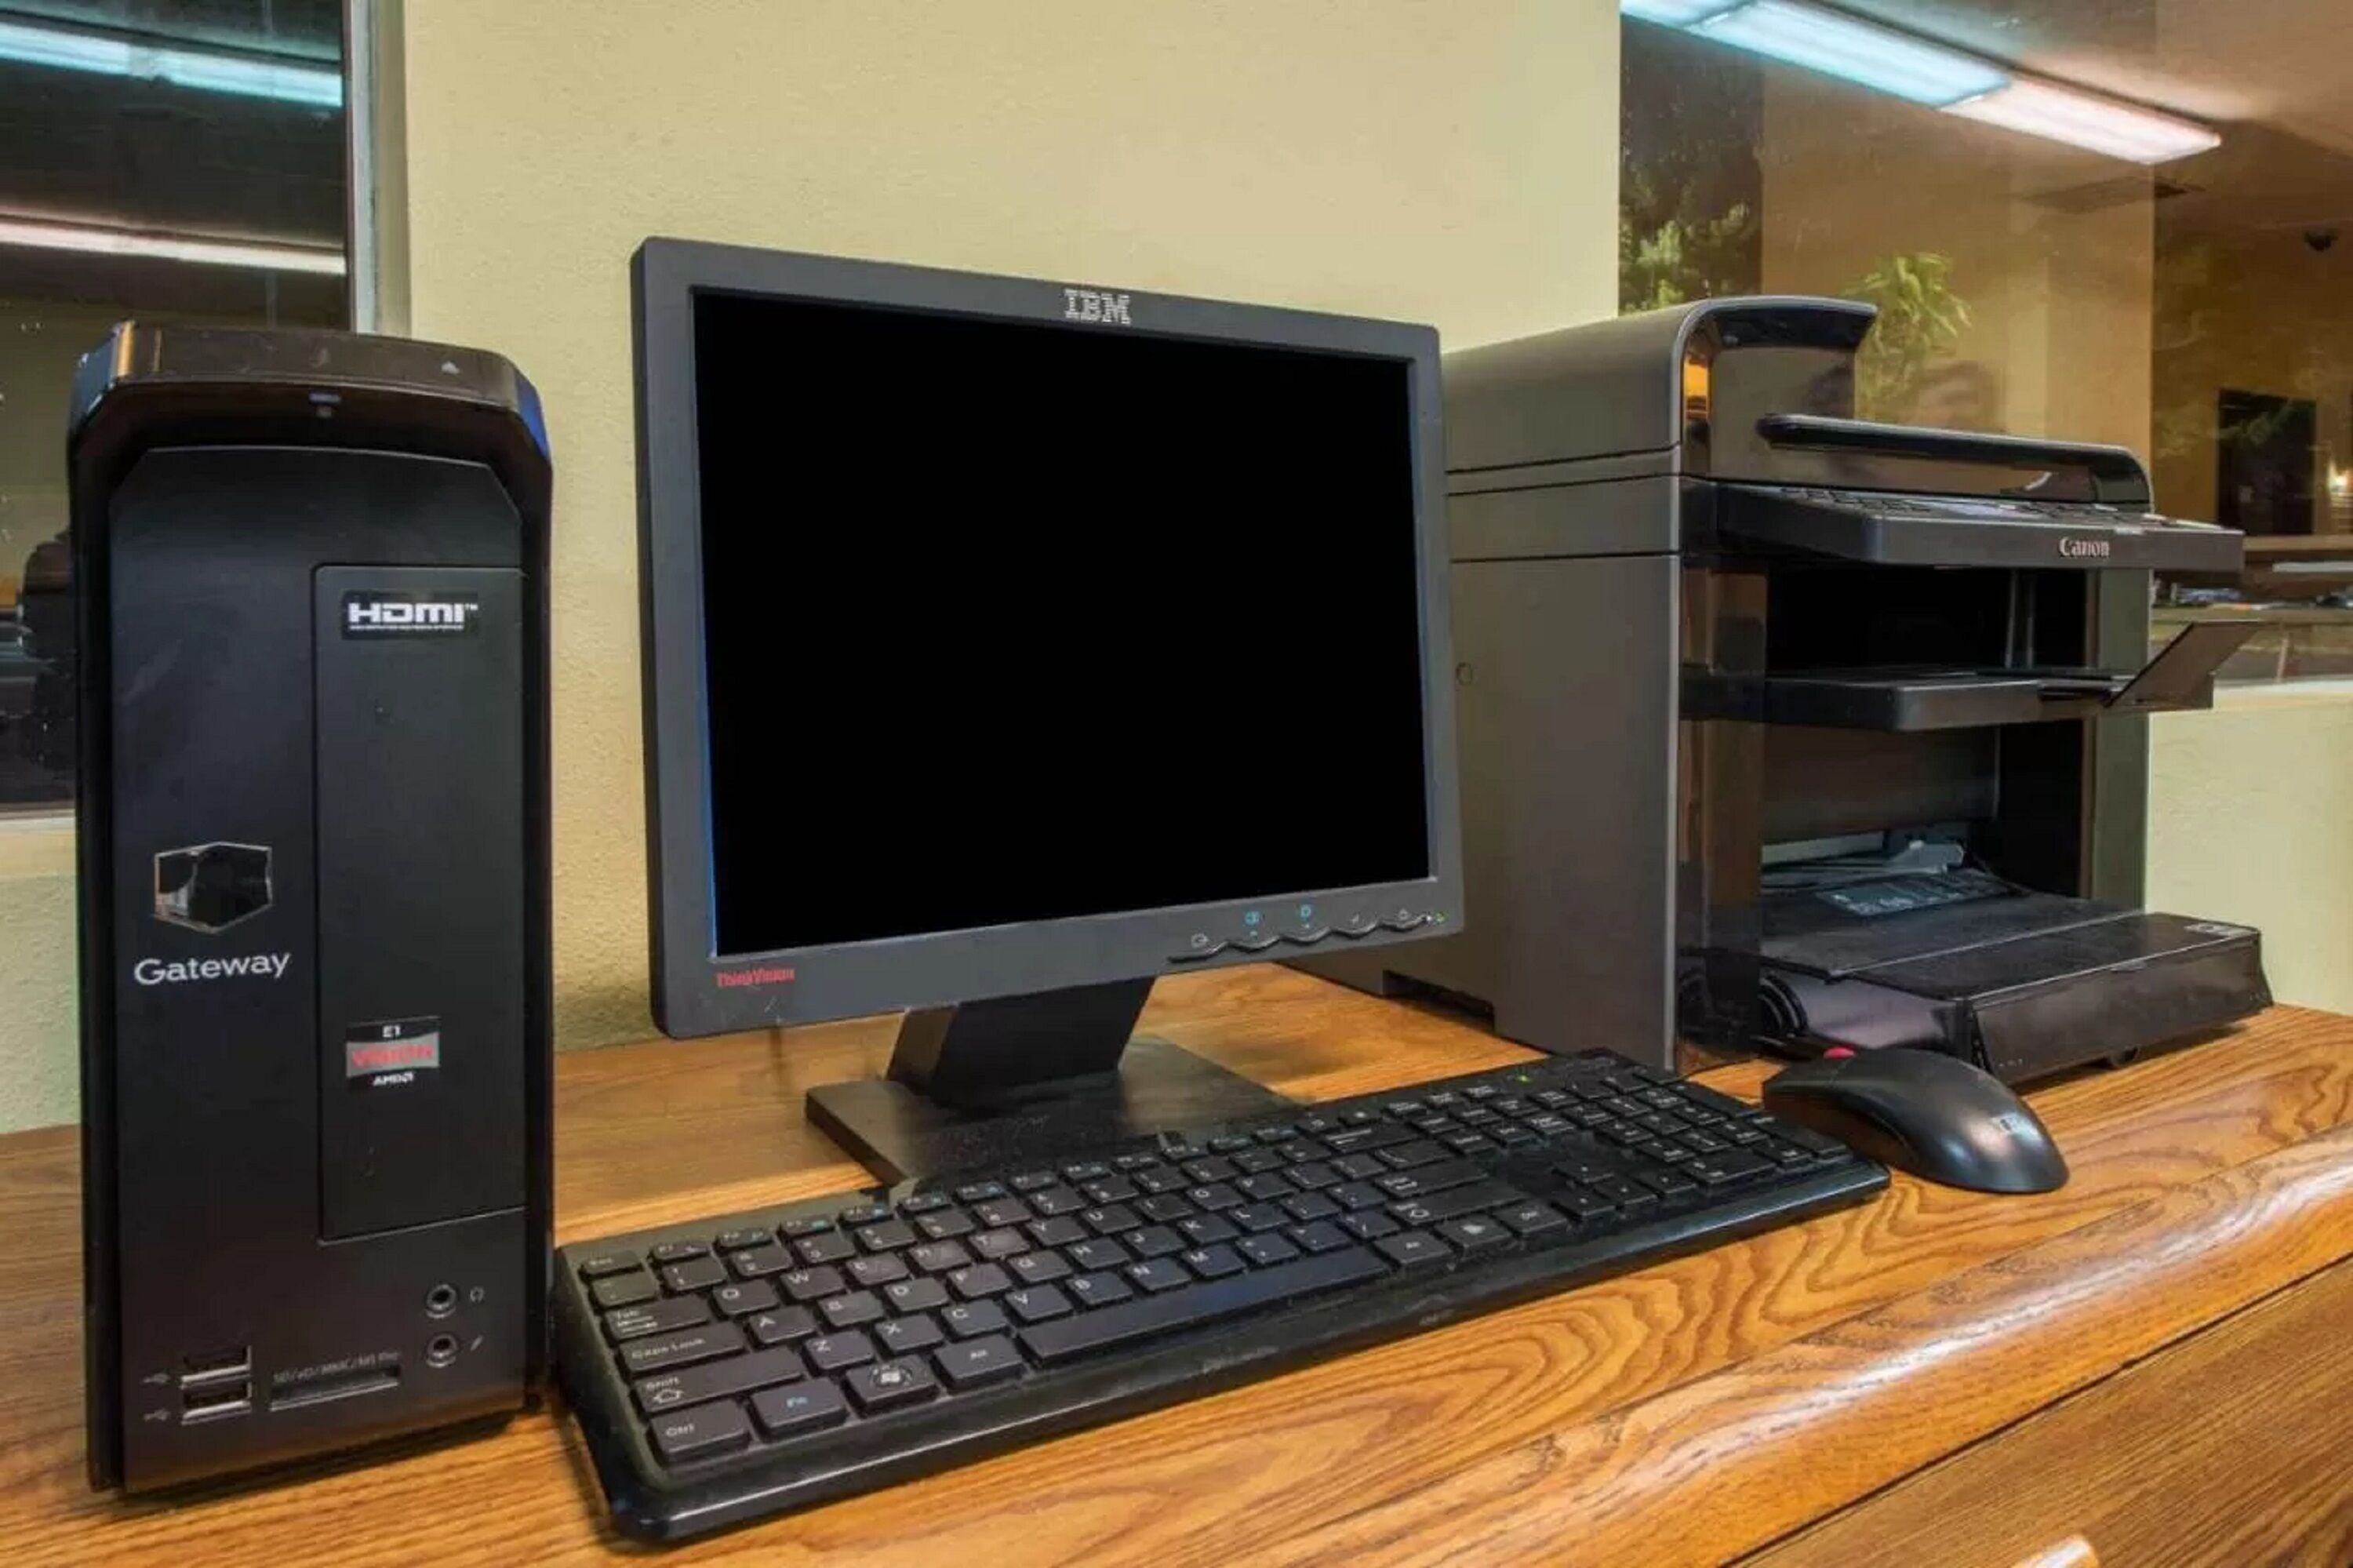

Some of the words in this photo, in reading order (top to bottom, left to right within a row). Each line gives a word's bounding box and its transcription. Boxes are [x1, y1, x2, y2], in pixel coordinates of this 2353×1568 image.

[1064, 288, 1131, 325] IBM
[2059, 537, 2110, 557] Canon
[134, 952, 291, 985] Gateway
[717, 968, 795, 988] ThinkVision
[788, 1271, 809, 1283] W
[759, 1316, 776, 1328] A
[886, 1322, 901, 1334] X
